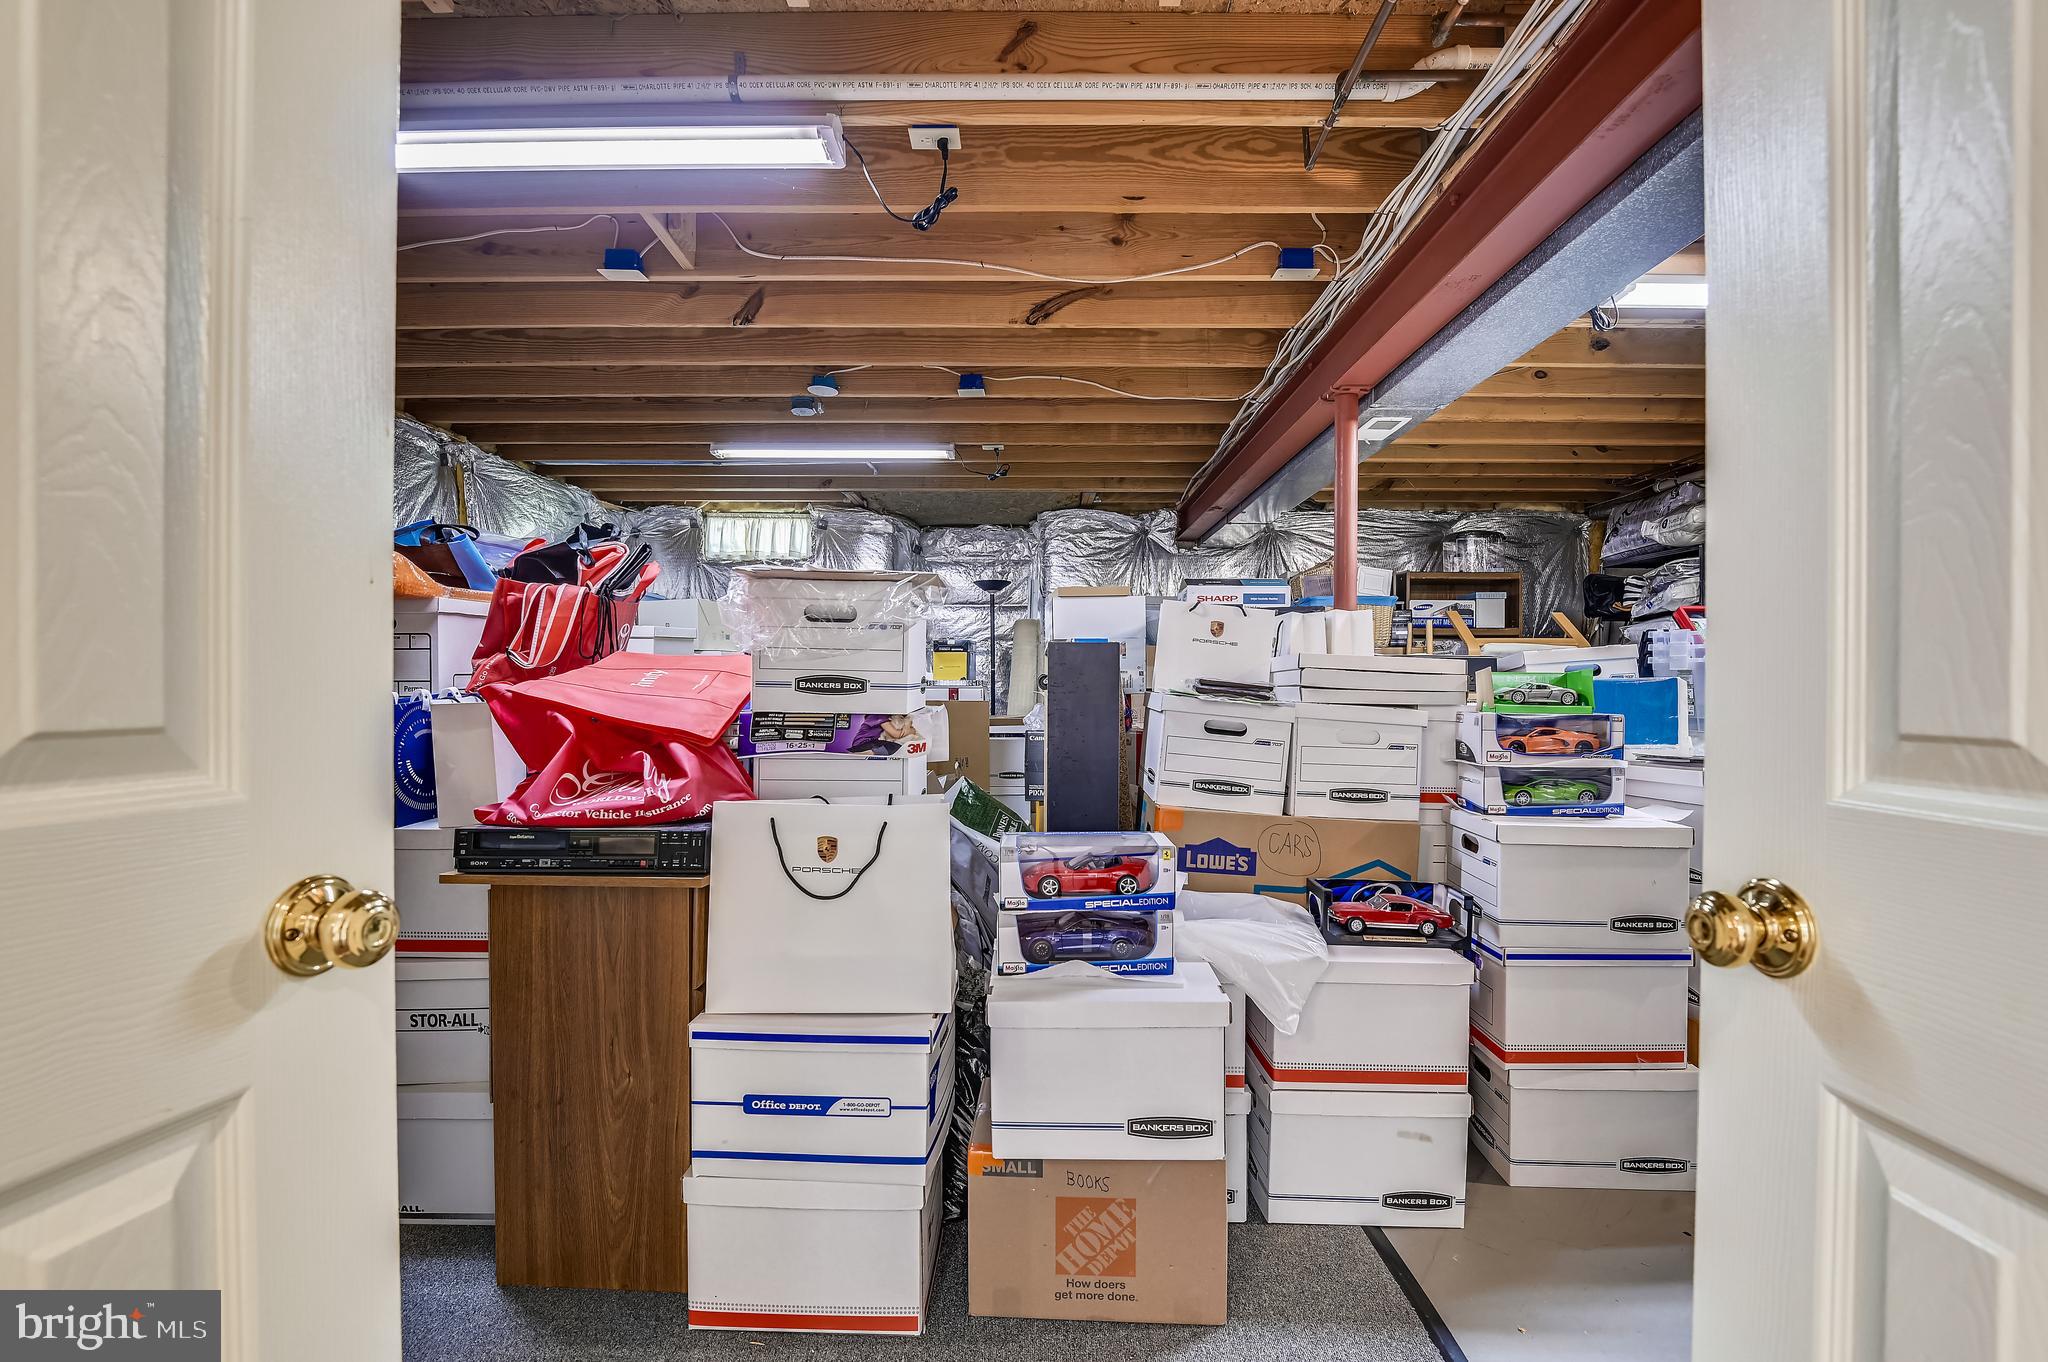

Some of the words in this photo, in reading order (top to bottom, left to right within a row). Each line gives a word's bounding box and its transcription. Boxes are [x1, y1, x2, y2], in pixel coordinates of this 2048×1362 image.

[483, 86, 511, 94] CELLULAR
[638, 82, 671, 90] CHARLOTTE
[673, 82, 685, 90] PIPE
[924, 81, 957, 89] CHARLOTTE
[959, 81, 972, 89] PIPE
[1213, 82, 1245, 90] CHARLOTTE
[1247, 82, 1260, 90] PIPE
[1192, 637, 1238, 647] PORSCHE
[404, 685, 423, 693] Perm
[799, 681, 841, 689] BANKERS
[843, 682, 862, 690] BOX
[907, 742, 926, 754] 3M
[1195, 782, 1231, 791] BANKERS
[1232, 785, 1248, 793] BOX
[585, 808, 632, 820] Vehicle
[1269, 831, 1315, 859] CARS
[1185, 850, 1249, 872] LOWE'S
[791, 866, 861, 875] PORSCHE
[1006, 899, 1026, 908] Maisto
[1614, 921, 1654, 929] BANKERS
[1656, 921, 1674, 929] BOX
[1005, 963, 1024, 972] Maisto
[751, 1100, 786, 1110] Office
[1132, 1123, 1184, 1132] BANKERS
[1185, 1123, 1209, 1133] BOX
[982, 1161, 1037, 1174] SMALL
[1623, 1160, 1659, 1170] BANKERS
[1660, 1161, 1685, 1170] BOX
[1066, 1170, 1110, 1193] BOOKS
[1386, 1197, 1427, 1206] BANKERS
[1429, 1197, 1448, 1206] BOX
[1063, 1205, 1097, 1238] THE
[1056, 1198, 1137, 1276] HOME
[1087, 1227, 1137, 1276] DEPOT
[1066, 1278, 1091, 1289] How
[1094, 1279, 1126, 1290] doers
[1054, 1290, 1073, 1301] get
[1075, 1292, 1105, 1301] more
[1107, 1291, 1139, 1302] done.
